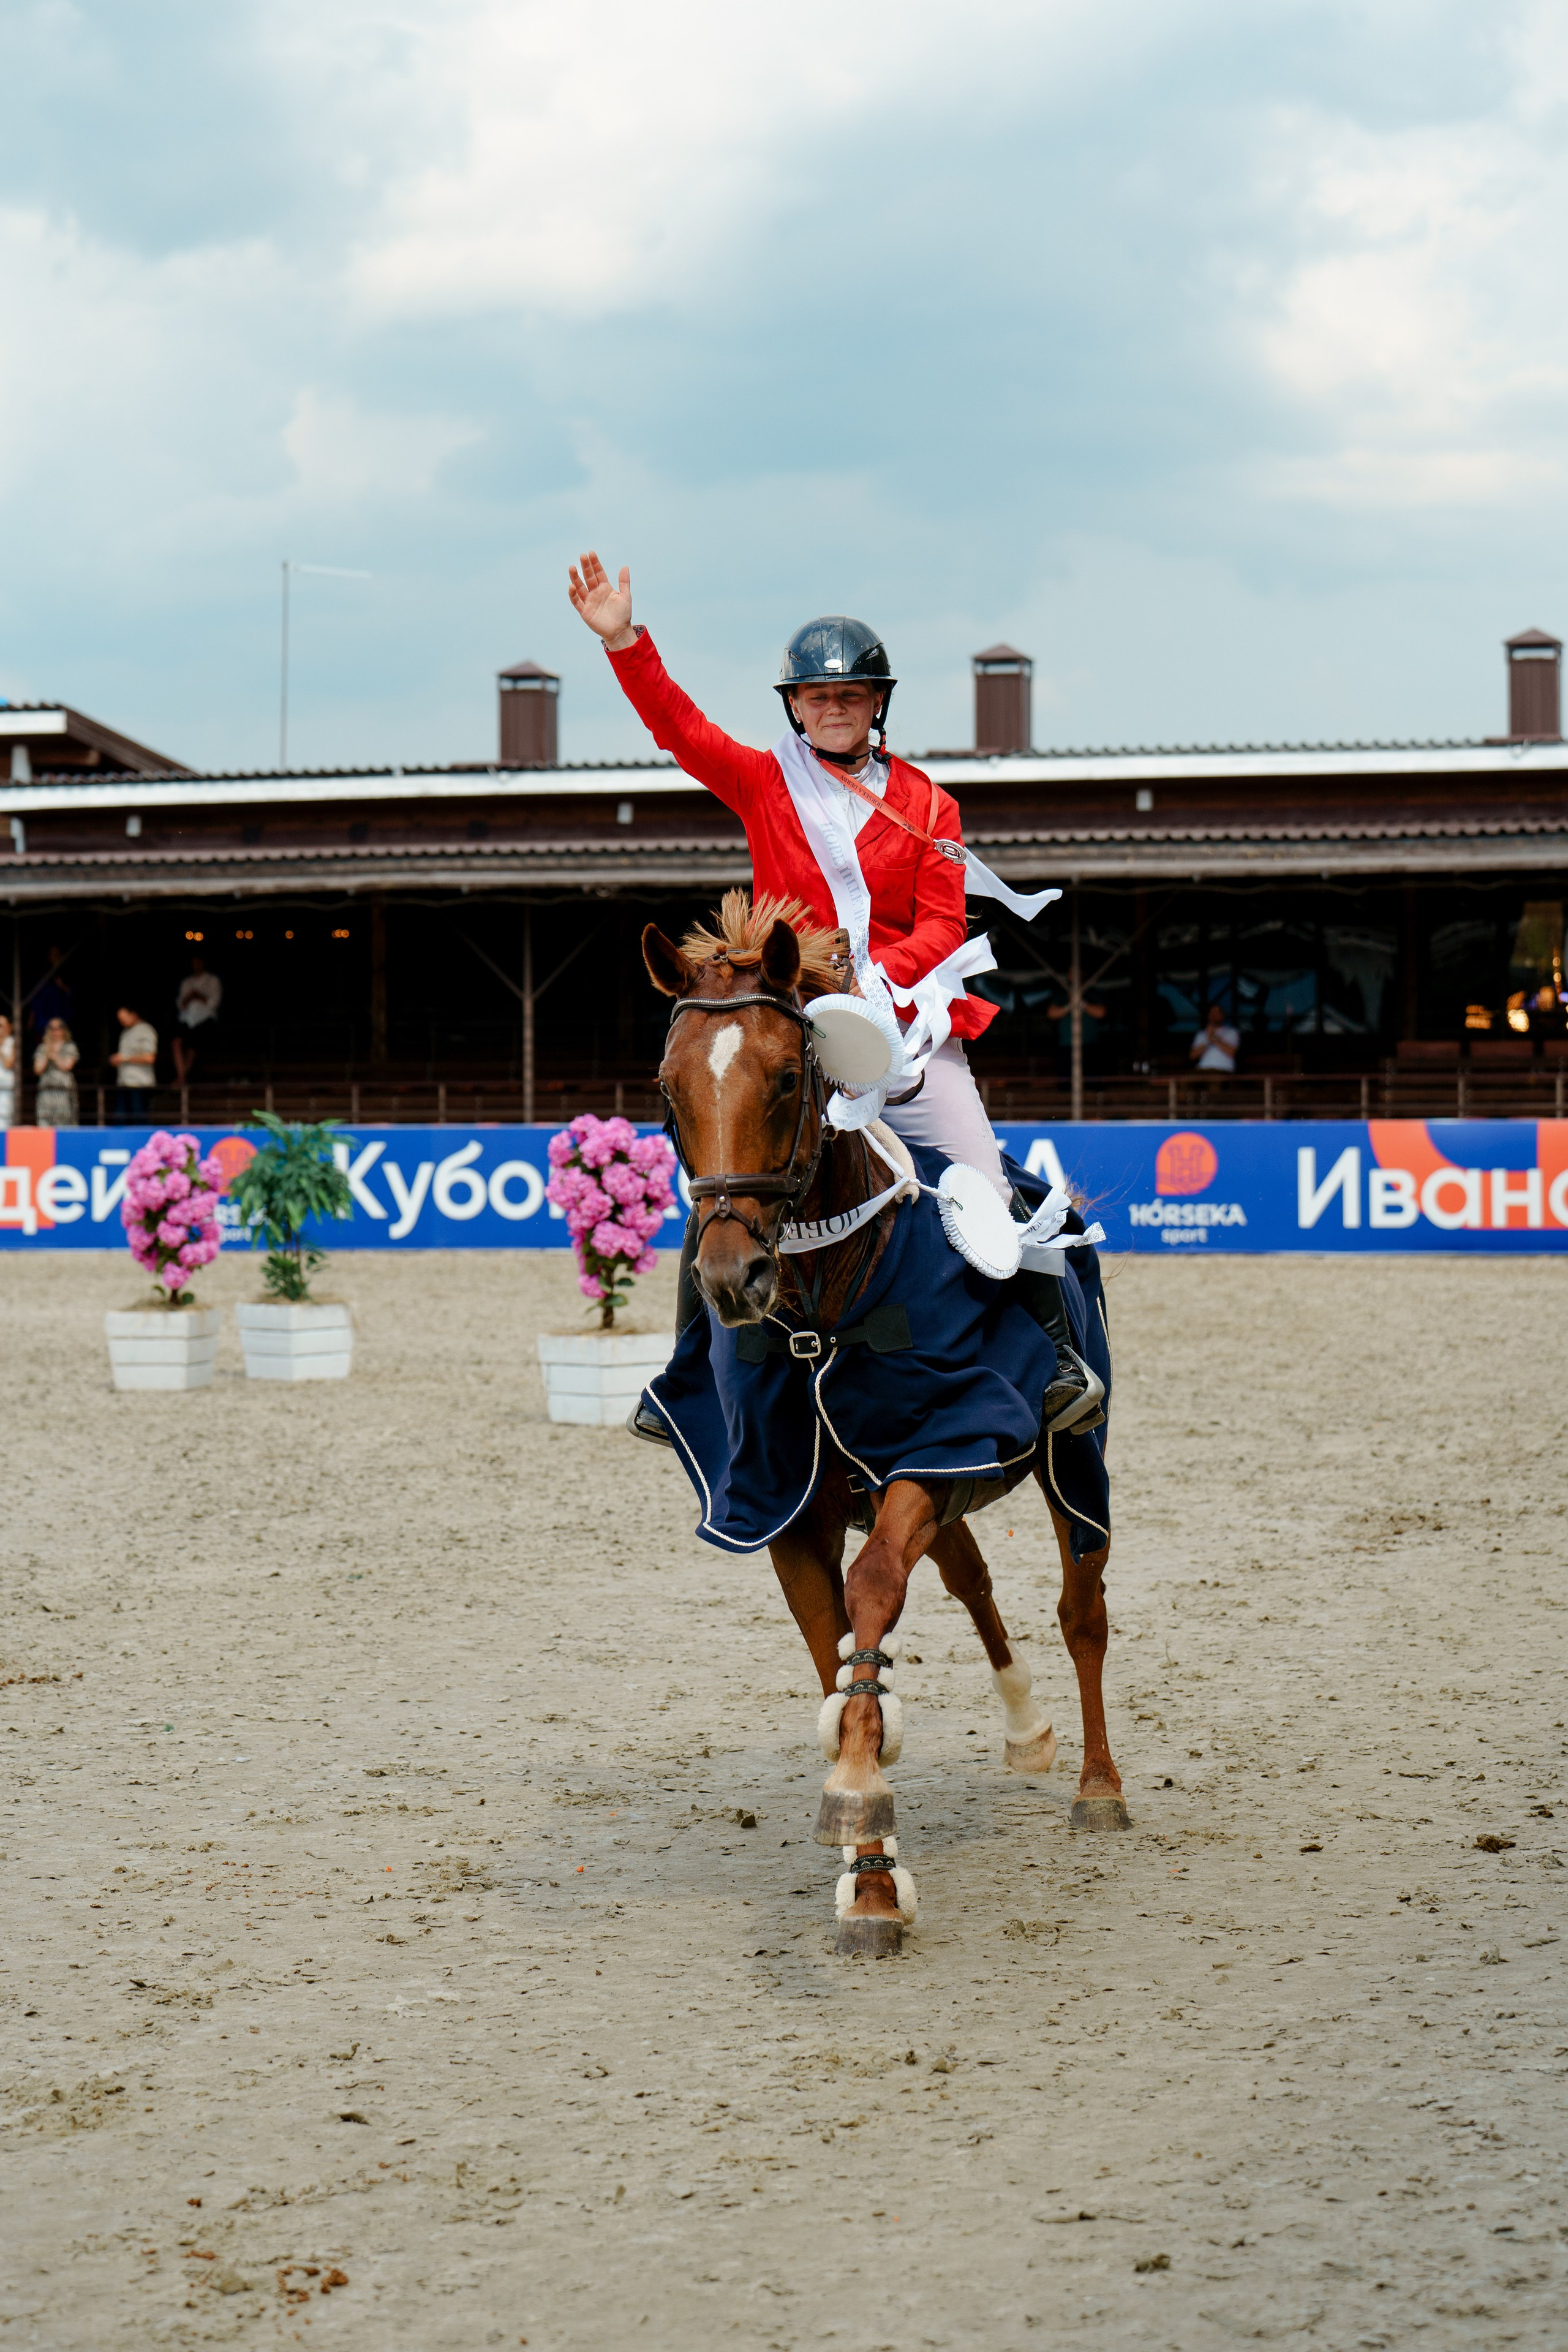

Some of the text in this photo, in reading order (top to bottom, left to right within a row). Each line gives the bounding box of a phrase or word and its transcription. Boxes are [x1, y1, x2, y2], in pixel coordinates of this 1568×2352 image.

[840, 775, 883, 809] HORSEKA DERBY
[1161, 1227, 1208, 1246] sport
